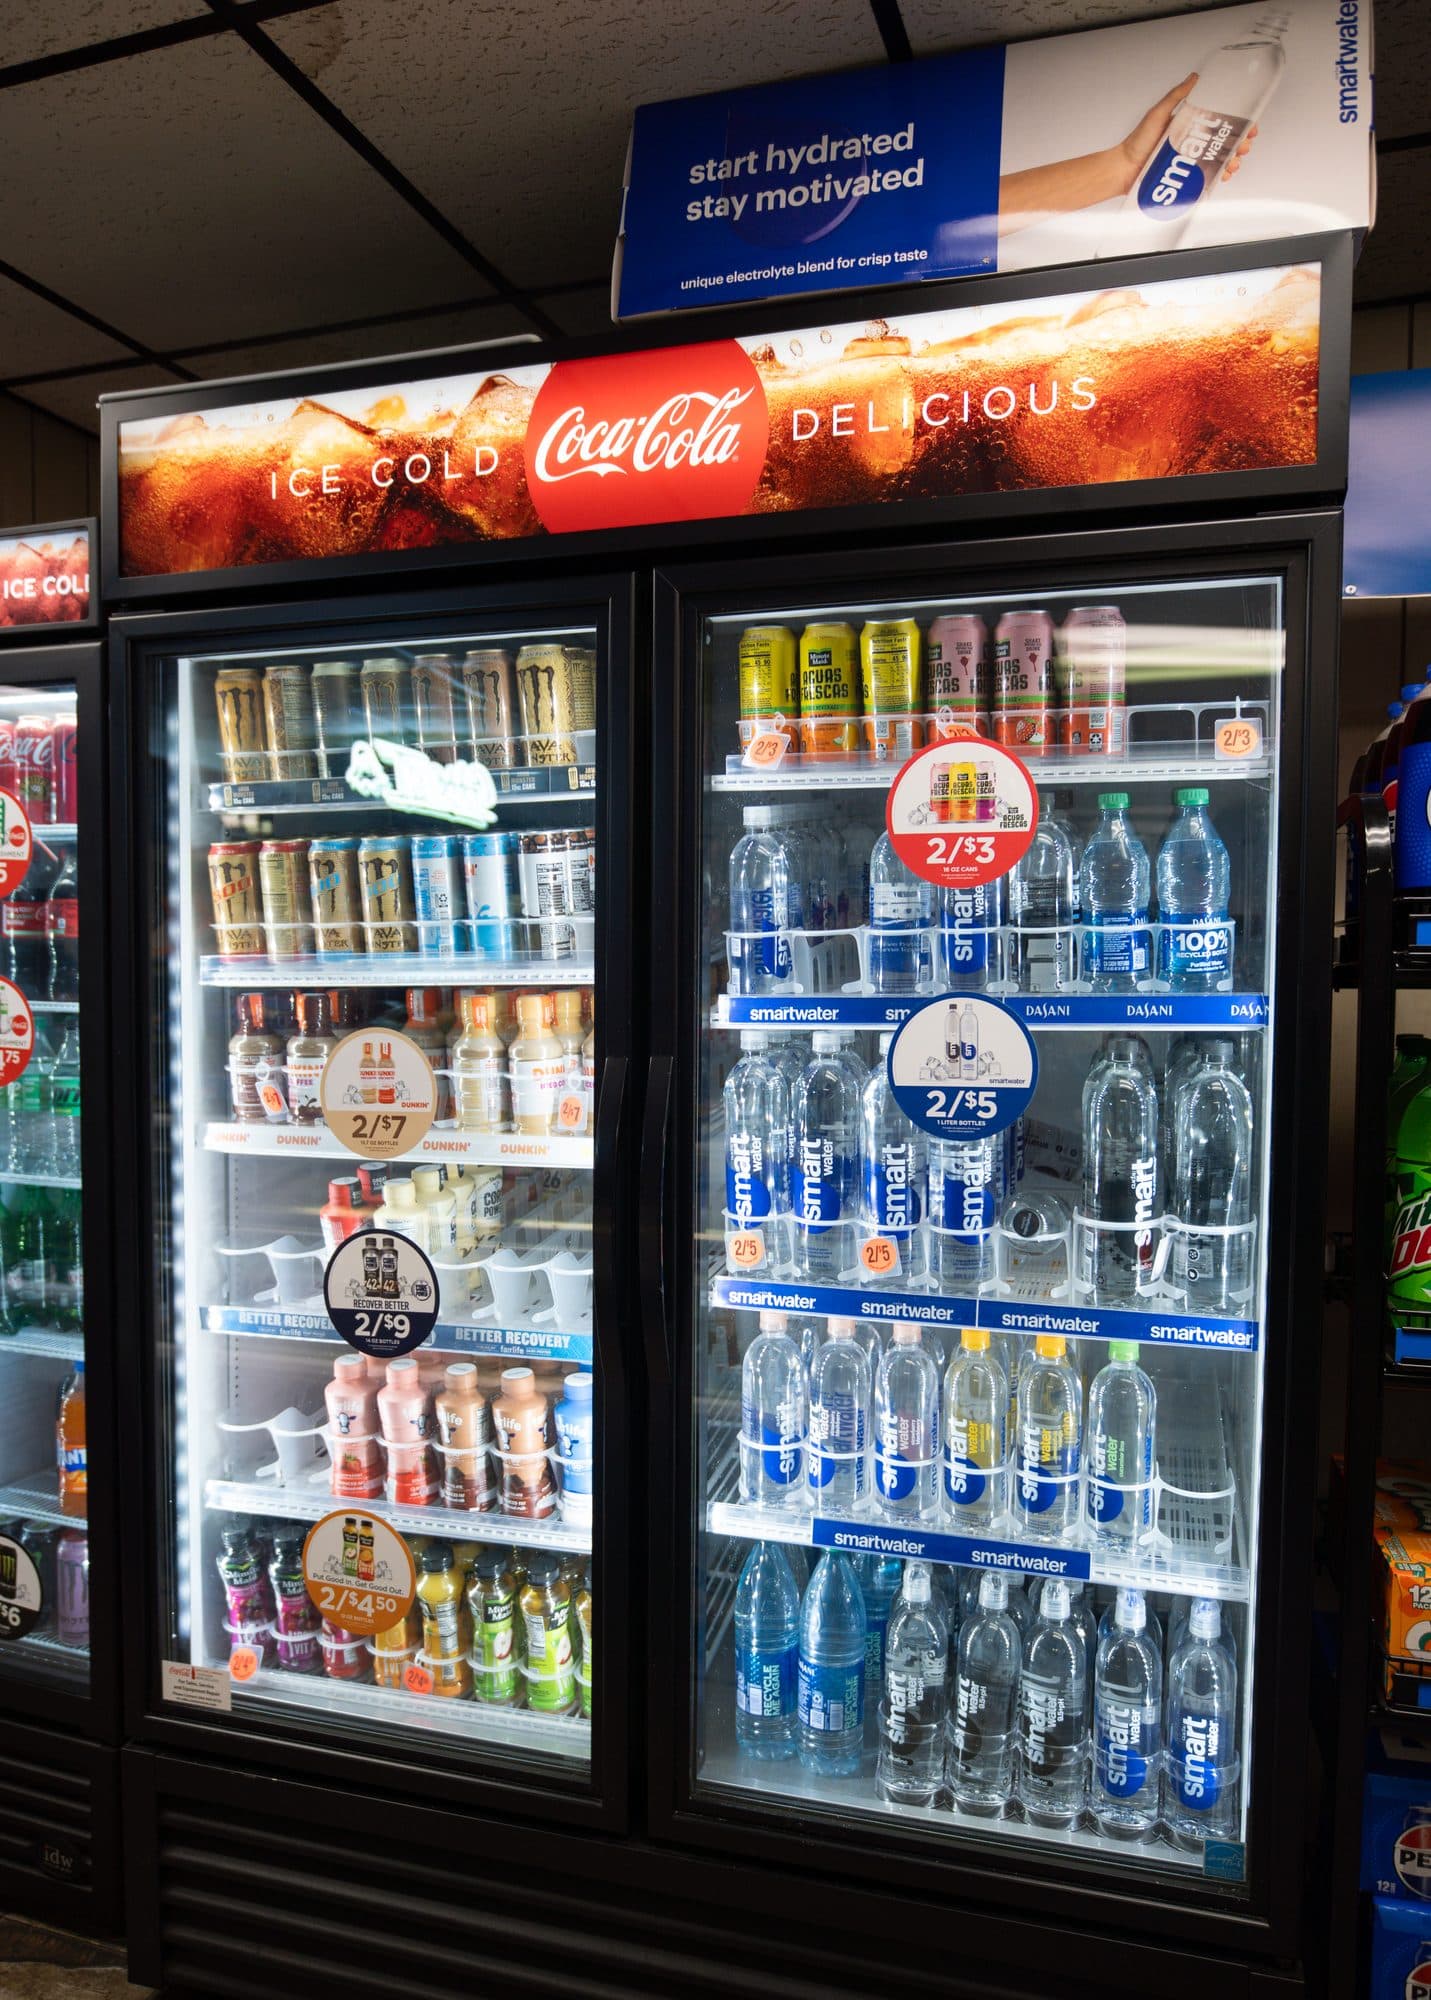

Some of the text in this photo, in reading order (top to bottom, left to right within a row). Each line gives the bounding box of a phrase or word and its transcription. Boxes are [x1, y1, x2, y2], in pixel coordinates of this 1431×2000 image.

[689, 122, 915, 185] start hydrated
[1203, 120, 1234, 162] water
[1151, 113, 1220, 207] smart
[686, 158, 925, 221] stay motivated
[680, 248, 928, 290] unique electrolyte blend for crisp taste
[793, 377, 1097, 440] DELICIOUS
[535, 385, 755, 481] Coca-Cola
[271, 446, 499, 499] ICE COLD
[3, 578, 37, 599] ICE
[803, 668, 842, 685] AGUAS
[929, 662, 952, 678] UAS
[926, 836, 996, 865] 2/$3
[974, 886, 984, 916] wate
[954, 886, 973, 961] smar
[1175, 930, 1228, 951] 100%
[750, 1006, 839, 1021] smartwater
[1026, 1003, 1070, 1018] DASANI
[1127, 1003, 1173, 1018] DASANI
[926, 1090, 998, 1119] 2/$5
[276, 1135, 550, 1155] DUNKIN' DUNKIN' DUNKIN'
[352, 1115, 407, 1139] 2/$7
[750, 1135, 762, 1172] water
[823, 1139, 834, 1177] water
[983, 1145, 992, 1183] water
[800, 1138, 822, 1220] smart
[881, 1143, 906, 1228] smart
[963, 1142, 985, 1231] smart
[238, 1312, 281, 1325] BETTER
[353, 1299, 410, 1311] RECOVER BETTER
[728, 1290, 1254, 1346] smartwater smartwater smartwater smartwater
[354, 1312, 411, 1338] 2/$9
[456, 1327, 571, 1348] BETTER RECOVERY
[500, 1345, 525, 1355] fairlife
[899, 1417, 909, 1451] water
[968, 1420, 978, 1455] water
[1040, 1428, 1051, 1463] water
[1106, 1436, 1118, 1472] water
[834, 1531, 1068, 1574] smartwater smartwater
[312, 1572, 325, 1580] Put
[325, 1575, 344, 1584] Good
[355, 1580, 367, 1588] Get
[368, 1582, 388, 1592] Good
[1413, 1602, 1431, 1610] PAC
[763, 1665, 772, 1716] RECYCLE
[771, 1665, 780, 1716] ME AGAIN
[888, 1671, 907, 1744] smart
[907, 1675, 917, 1707] water
[969, 1681, 979, 1714] water
[1027, 1689, 1046, 1765] smart
[1047, 1695, 1057, 1728] water
[1130, 1709, 1141, 1745] water
[1108, 1705, 1130, 1787] smart
[1207, 1720, 1219, 1756] water
[1182, 1715, 1208, 1798] smart
